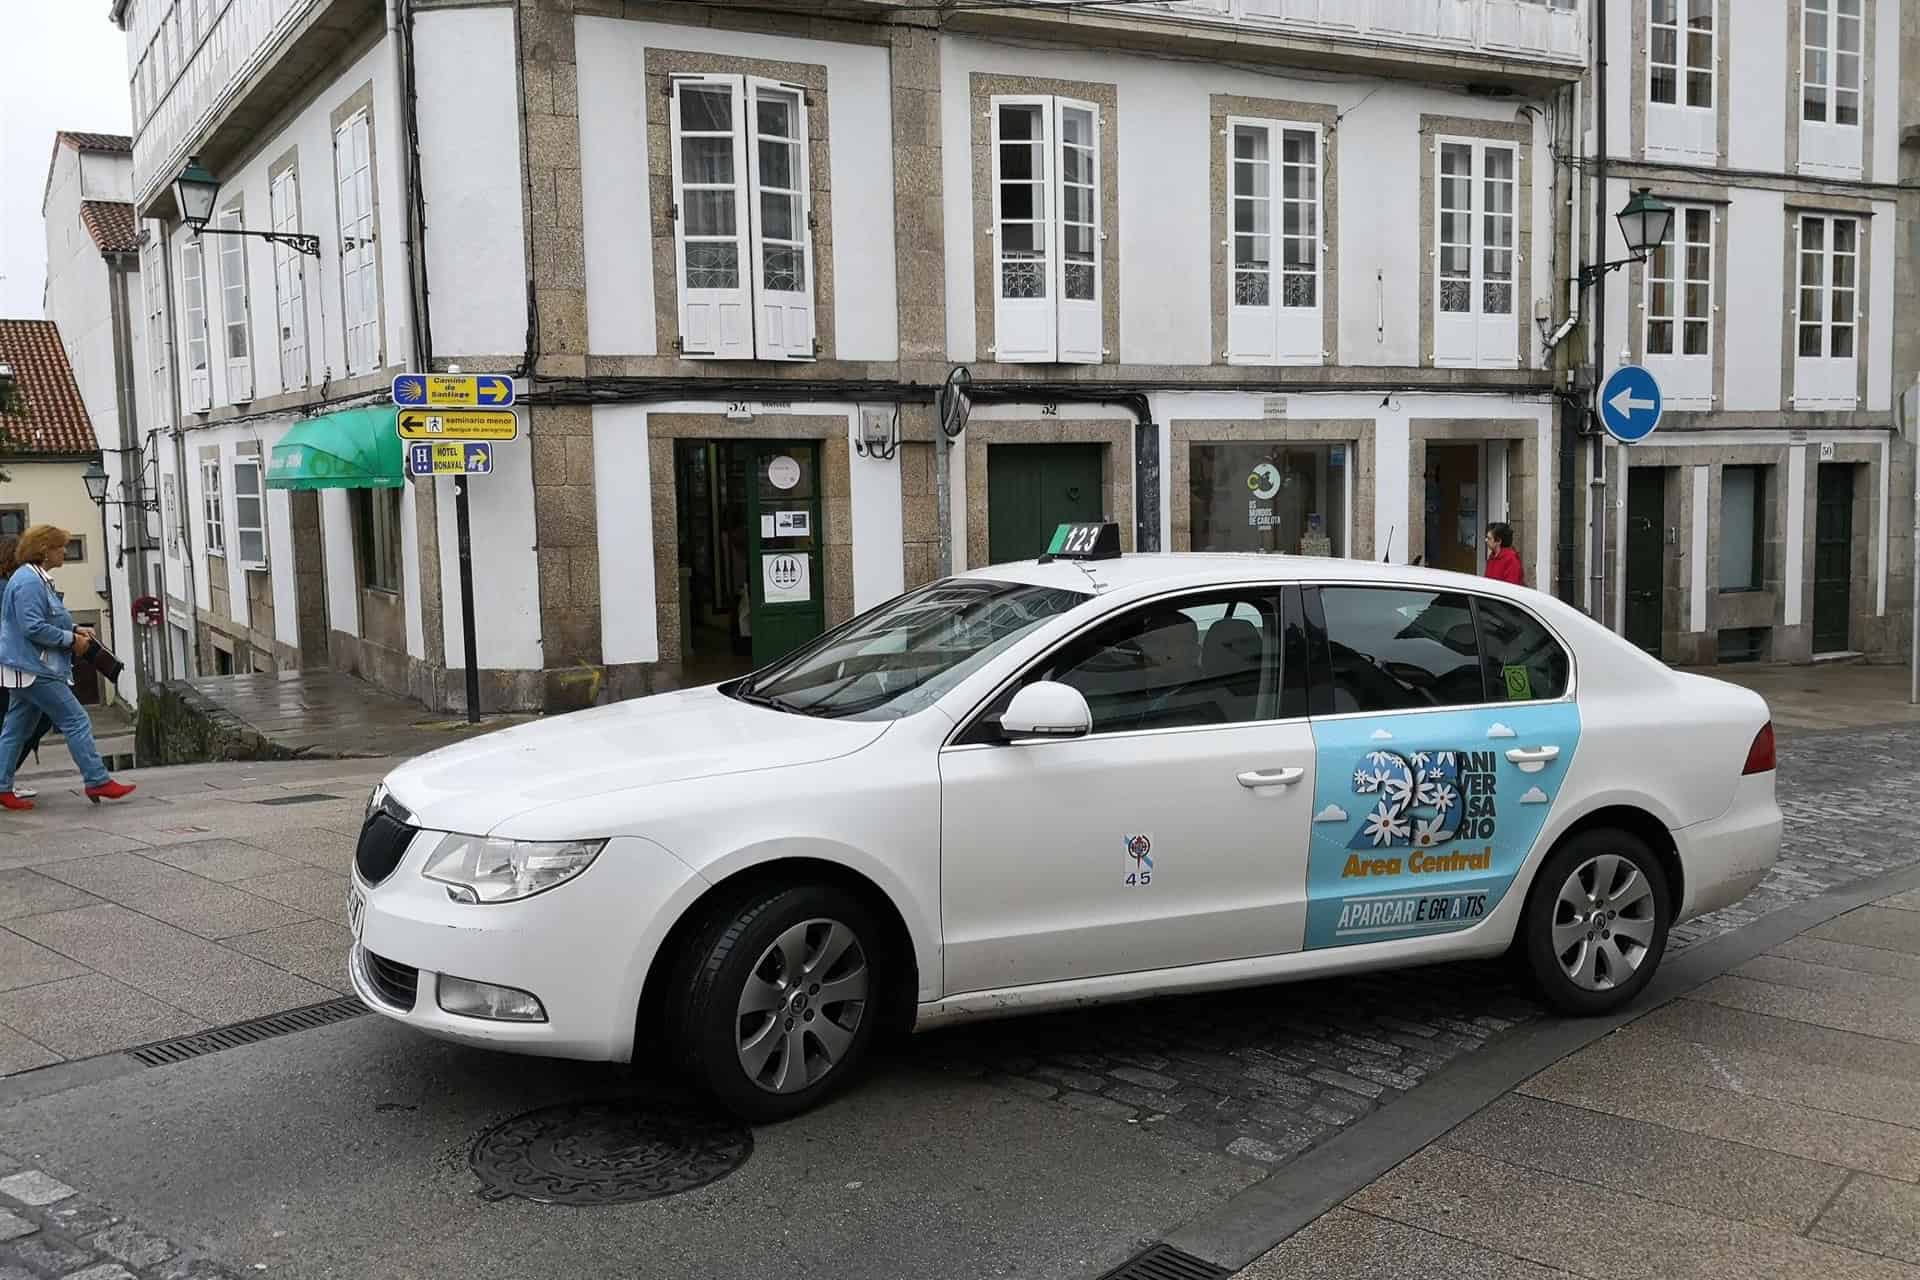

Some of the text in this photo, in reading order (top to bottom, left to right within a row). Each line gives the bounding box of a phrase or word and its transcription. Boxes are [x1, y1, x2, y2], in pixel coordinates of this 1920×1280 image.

[432, 391, 470, 399] Santiago
[1042, 401, 1057, 415] 52
[446, 415, 512, 425] seminario menor
[437, 447, 458, 457] HOTEL
[433, 460, 464, 470] BONAVAL
[1257, 515, 1281, 525] CARLOTA
[1065, 526, 1099, 552] 123
[1459, 751, 1496, 772] ANI
[1346, 750, 1466, 850] 25
[1467, 795, 1496, 817] SA
[1456, 818, 1496, 840] RIO
[1342, 847, 1492, 878] Area Central
[1125, 871, 1151, 886] 45
[1337, 899, 1417, 929] APARCAR
